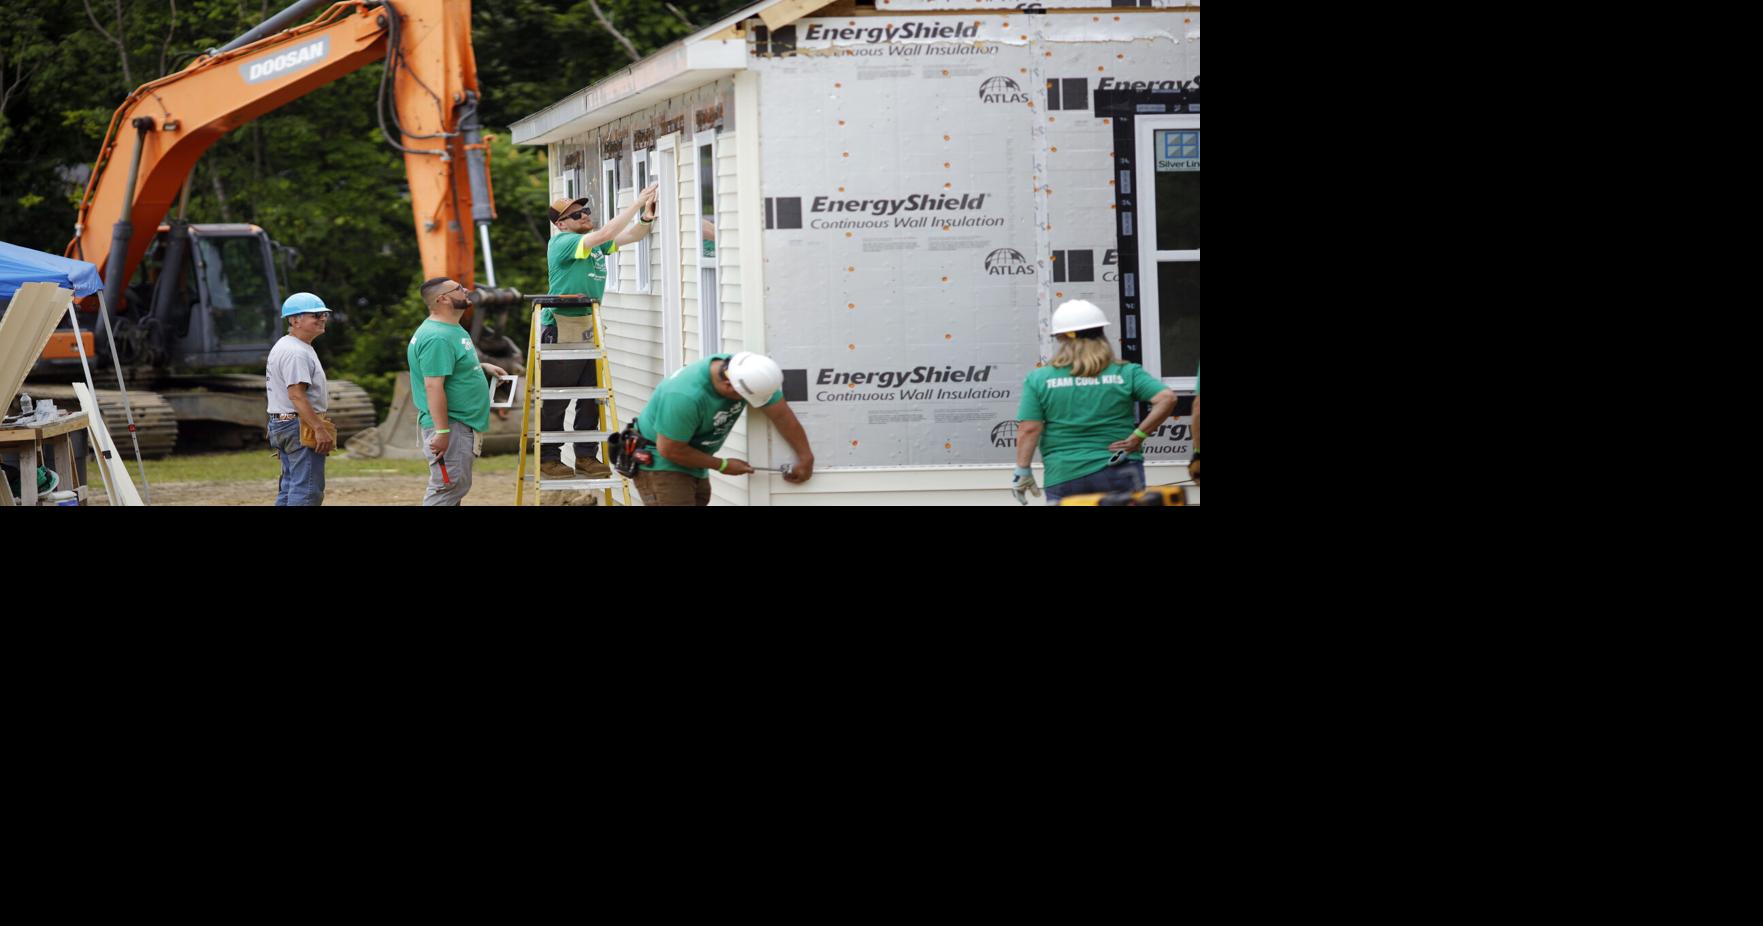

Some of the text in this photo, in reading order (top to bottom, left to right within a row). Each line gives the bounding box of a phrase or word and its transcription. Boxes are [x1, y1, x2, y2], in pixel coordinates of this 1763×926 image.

[805, 22, 978, 43] EnergyShield
[888, 45, 921, 56] Wall
[926, 44, 1000, 56] Insulation
[249, 41, 324, 81] DOOSAN
[983, 93, 1030, 103] ATLAS
[1158, 160, 1200, 168] Silver Lin
[810, 193, 986, 216] EnergyShield
[810, 215, 1005, 229] Continuous Wall Insulation
[988, 265, 1035, 275] ATLAS
[816, 365, 992, 388] EnergyShield
[1046, 377, 1074, 389] TEAM
[1075, 376, 1100, 387] COOL
[816, 387, 1011, 402] Continuous Wall Insulation
